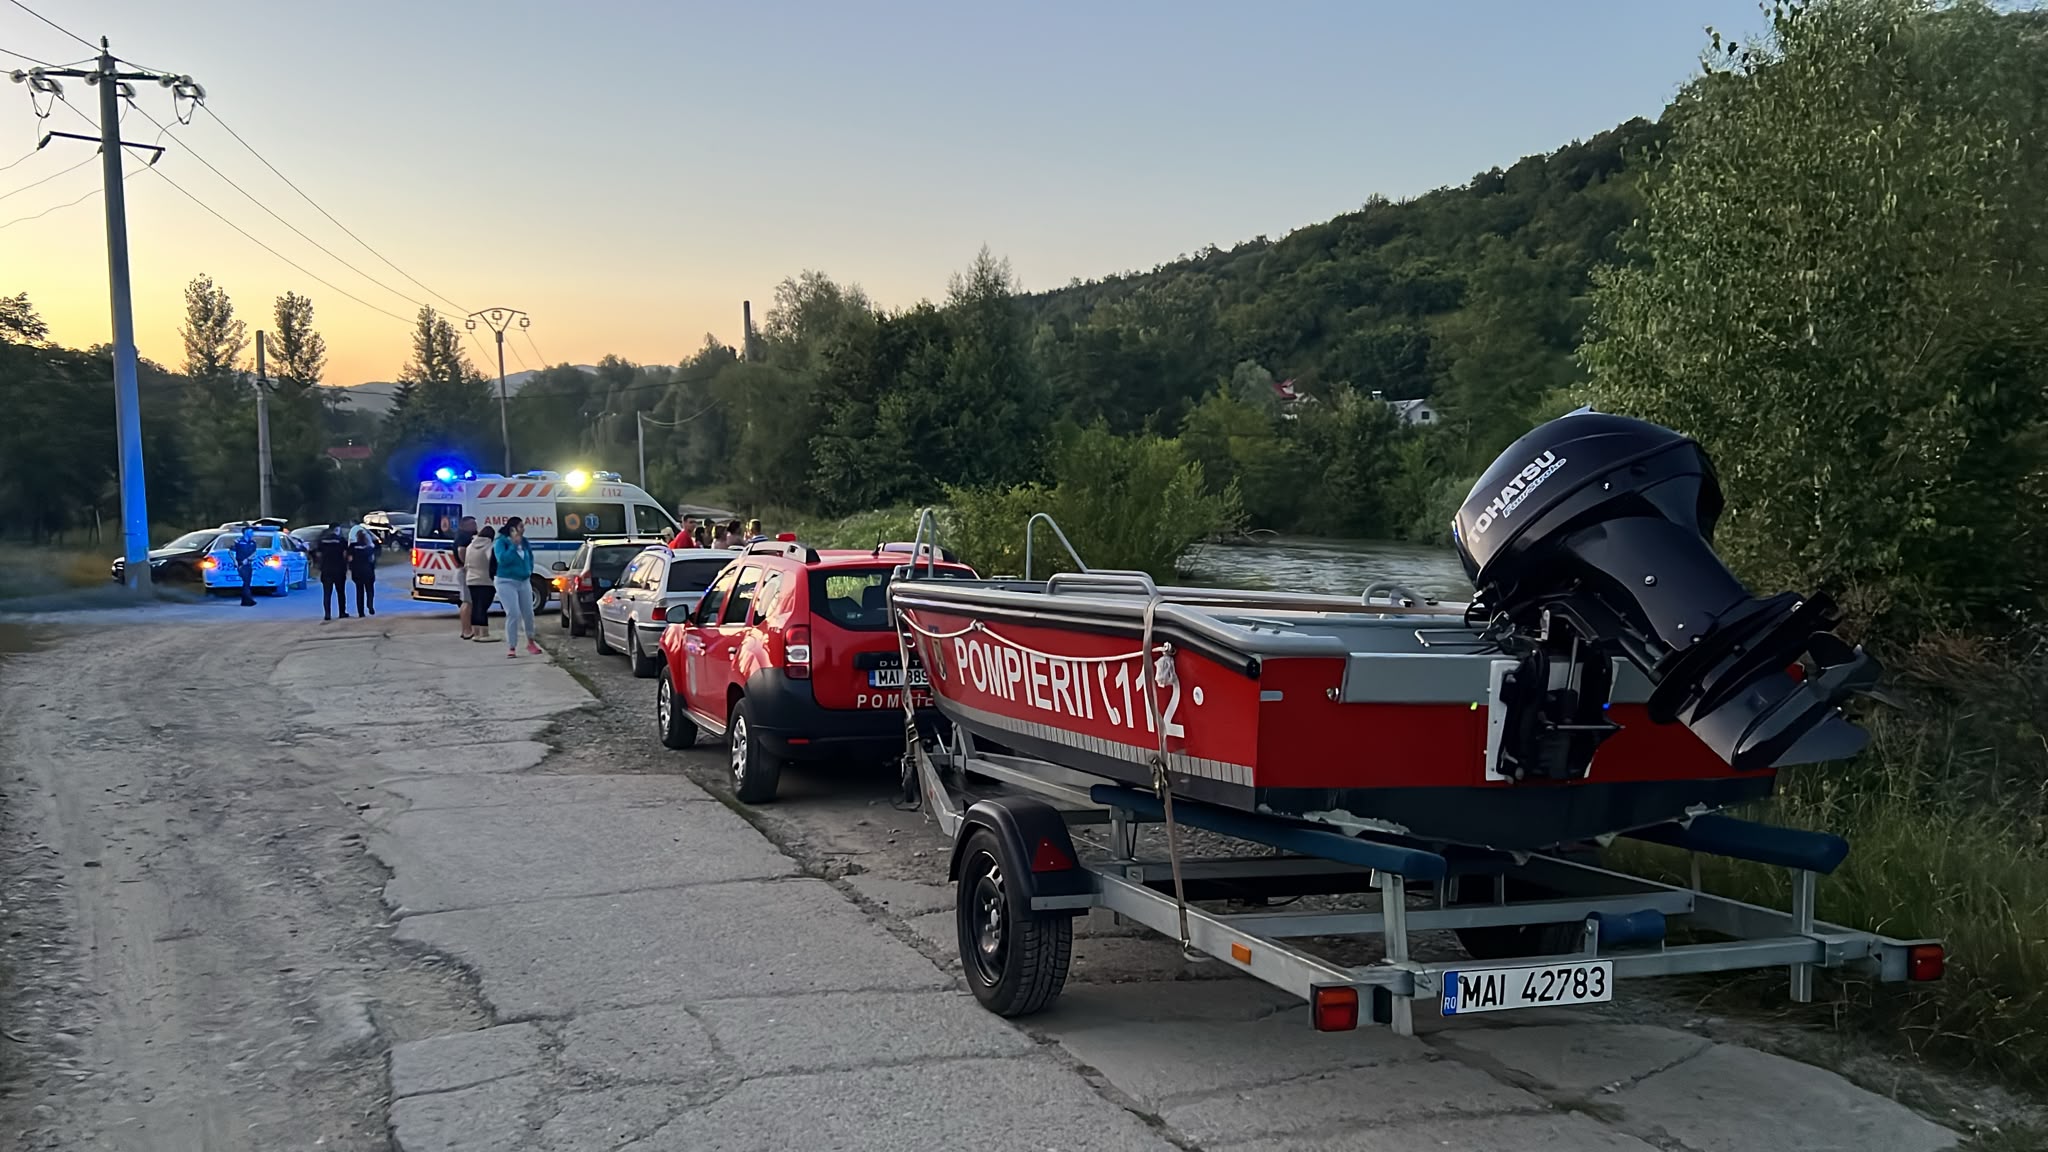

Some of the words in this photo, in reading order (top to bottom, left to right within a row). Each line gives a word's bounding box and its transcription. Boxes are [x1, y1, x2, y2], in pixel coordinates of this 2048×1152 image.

[1467, 450, 1556, 544] TOHATSU
[484, 516, 553, 528] AMBANȚA
[878, 670, 900, 685] MAI
[954, 636, 1094, 720] POMPIERII
[1115, 661, 1185, 739] 112
[1443, 996, 1457, 1010] RO
[1461, 974, 1506, 1009] MAI
[1521, 966, 1606, 1003] 42783
